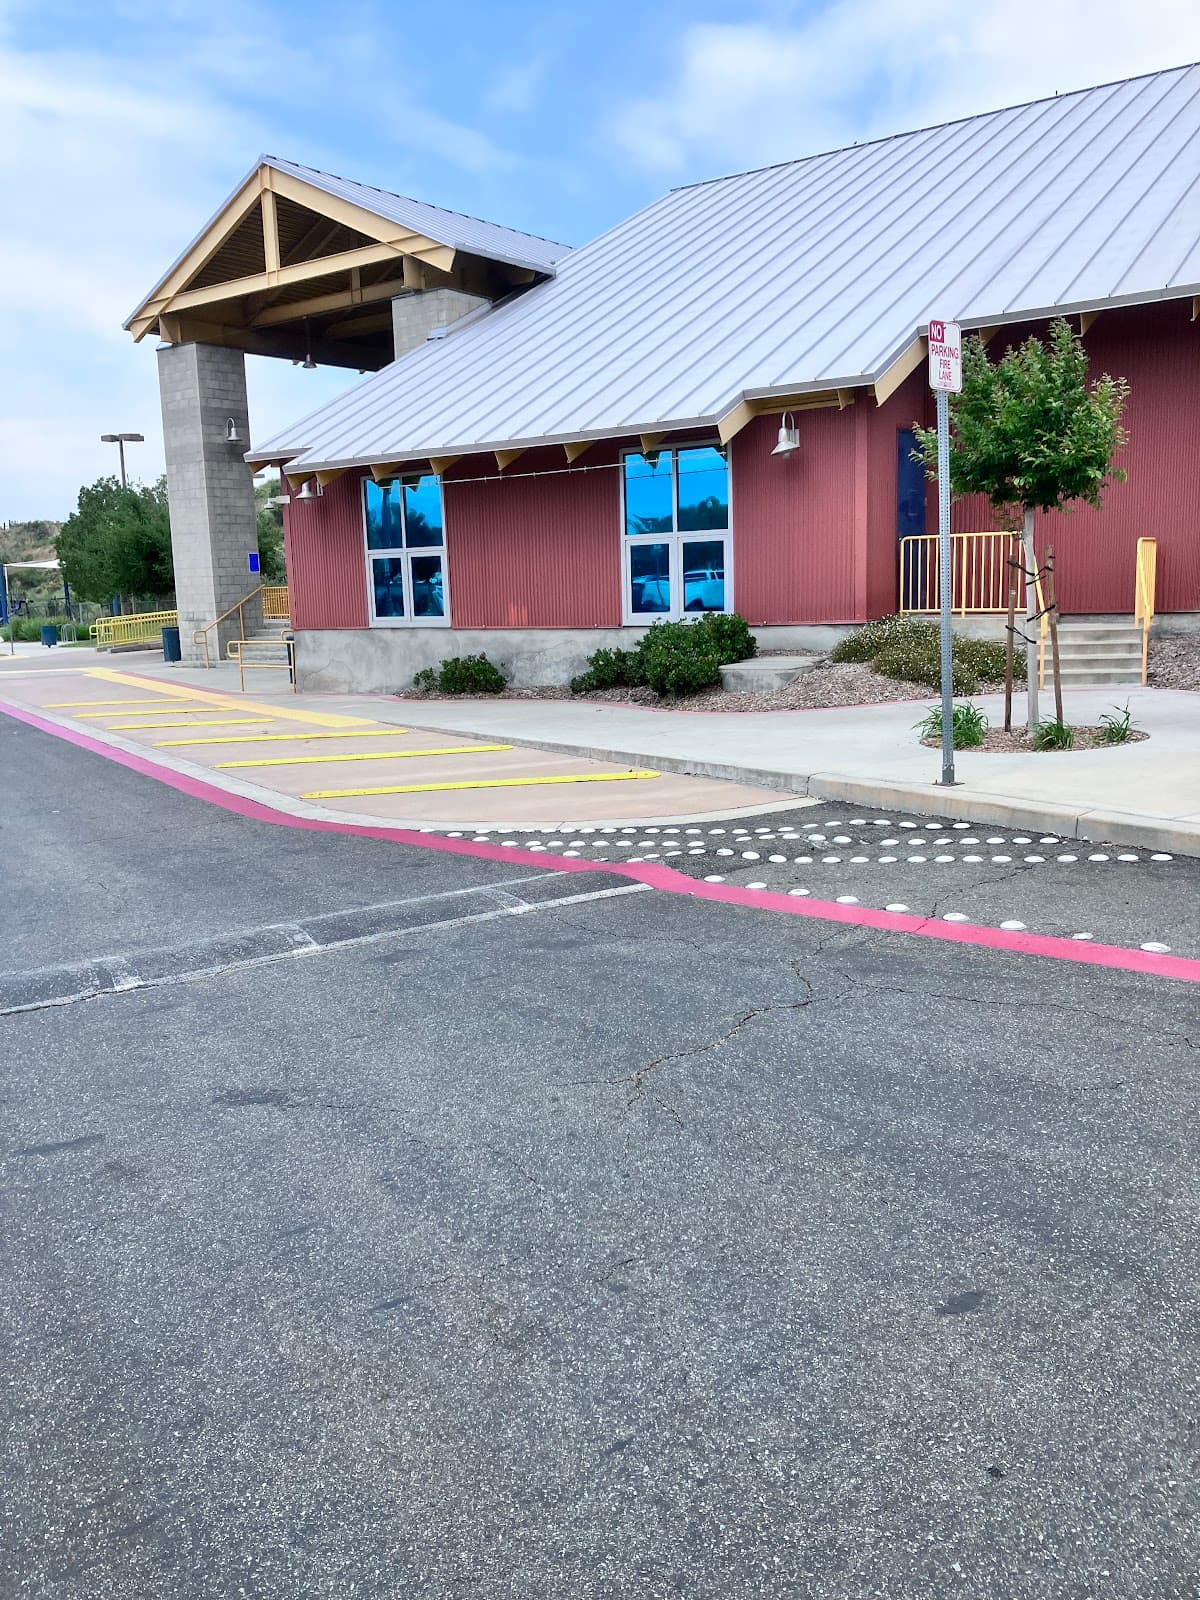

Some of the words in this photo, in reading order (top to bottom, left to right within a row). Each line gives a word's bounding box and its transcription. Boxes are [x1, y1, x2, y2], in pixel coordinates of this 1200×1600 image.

[931, 324, 942, 340] NO
[931, 344, 959, 359] PARKING
[940, 359, 951, 369] FIRE
[939, 370, 952, 381] LANE
